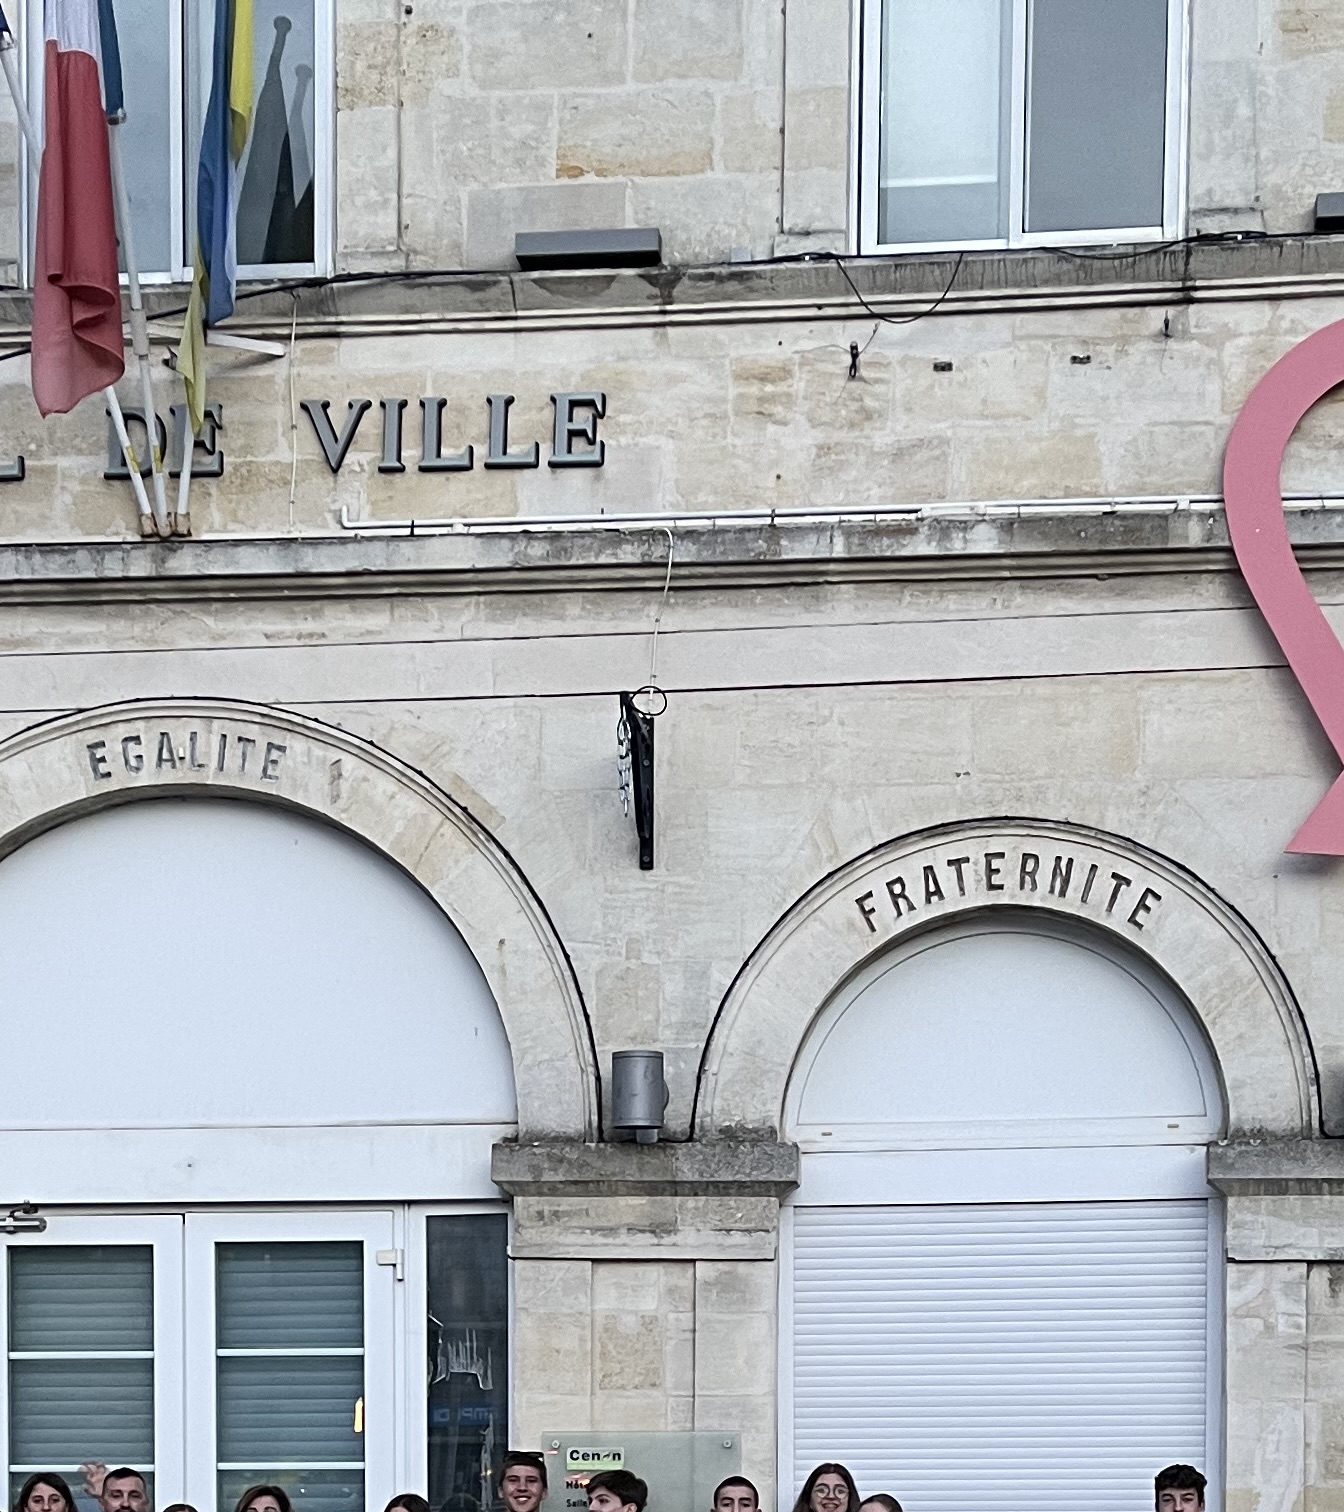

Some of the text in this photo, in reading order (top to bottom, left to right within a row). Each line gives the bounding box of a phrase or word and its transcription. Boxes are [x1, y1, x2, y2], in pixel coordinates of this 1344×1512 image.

[103, 403, 225, 481] DE
[300, 391, 607, 474] VILLE
[86, 731, 288, 781] EGALITE
[854, 851, 1162, 933] FRATERNITE
